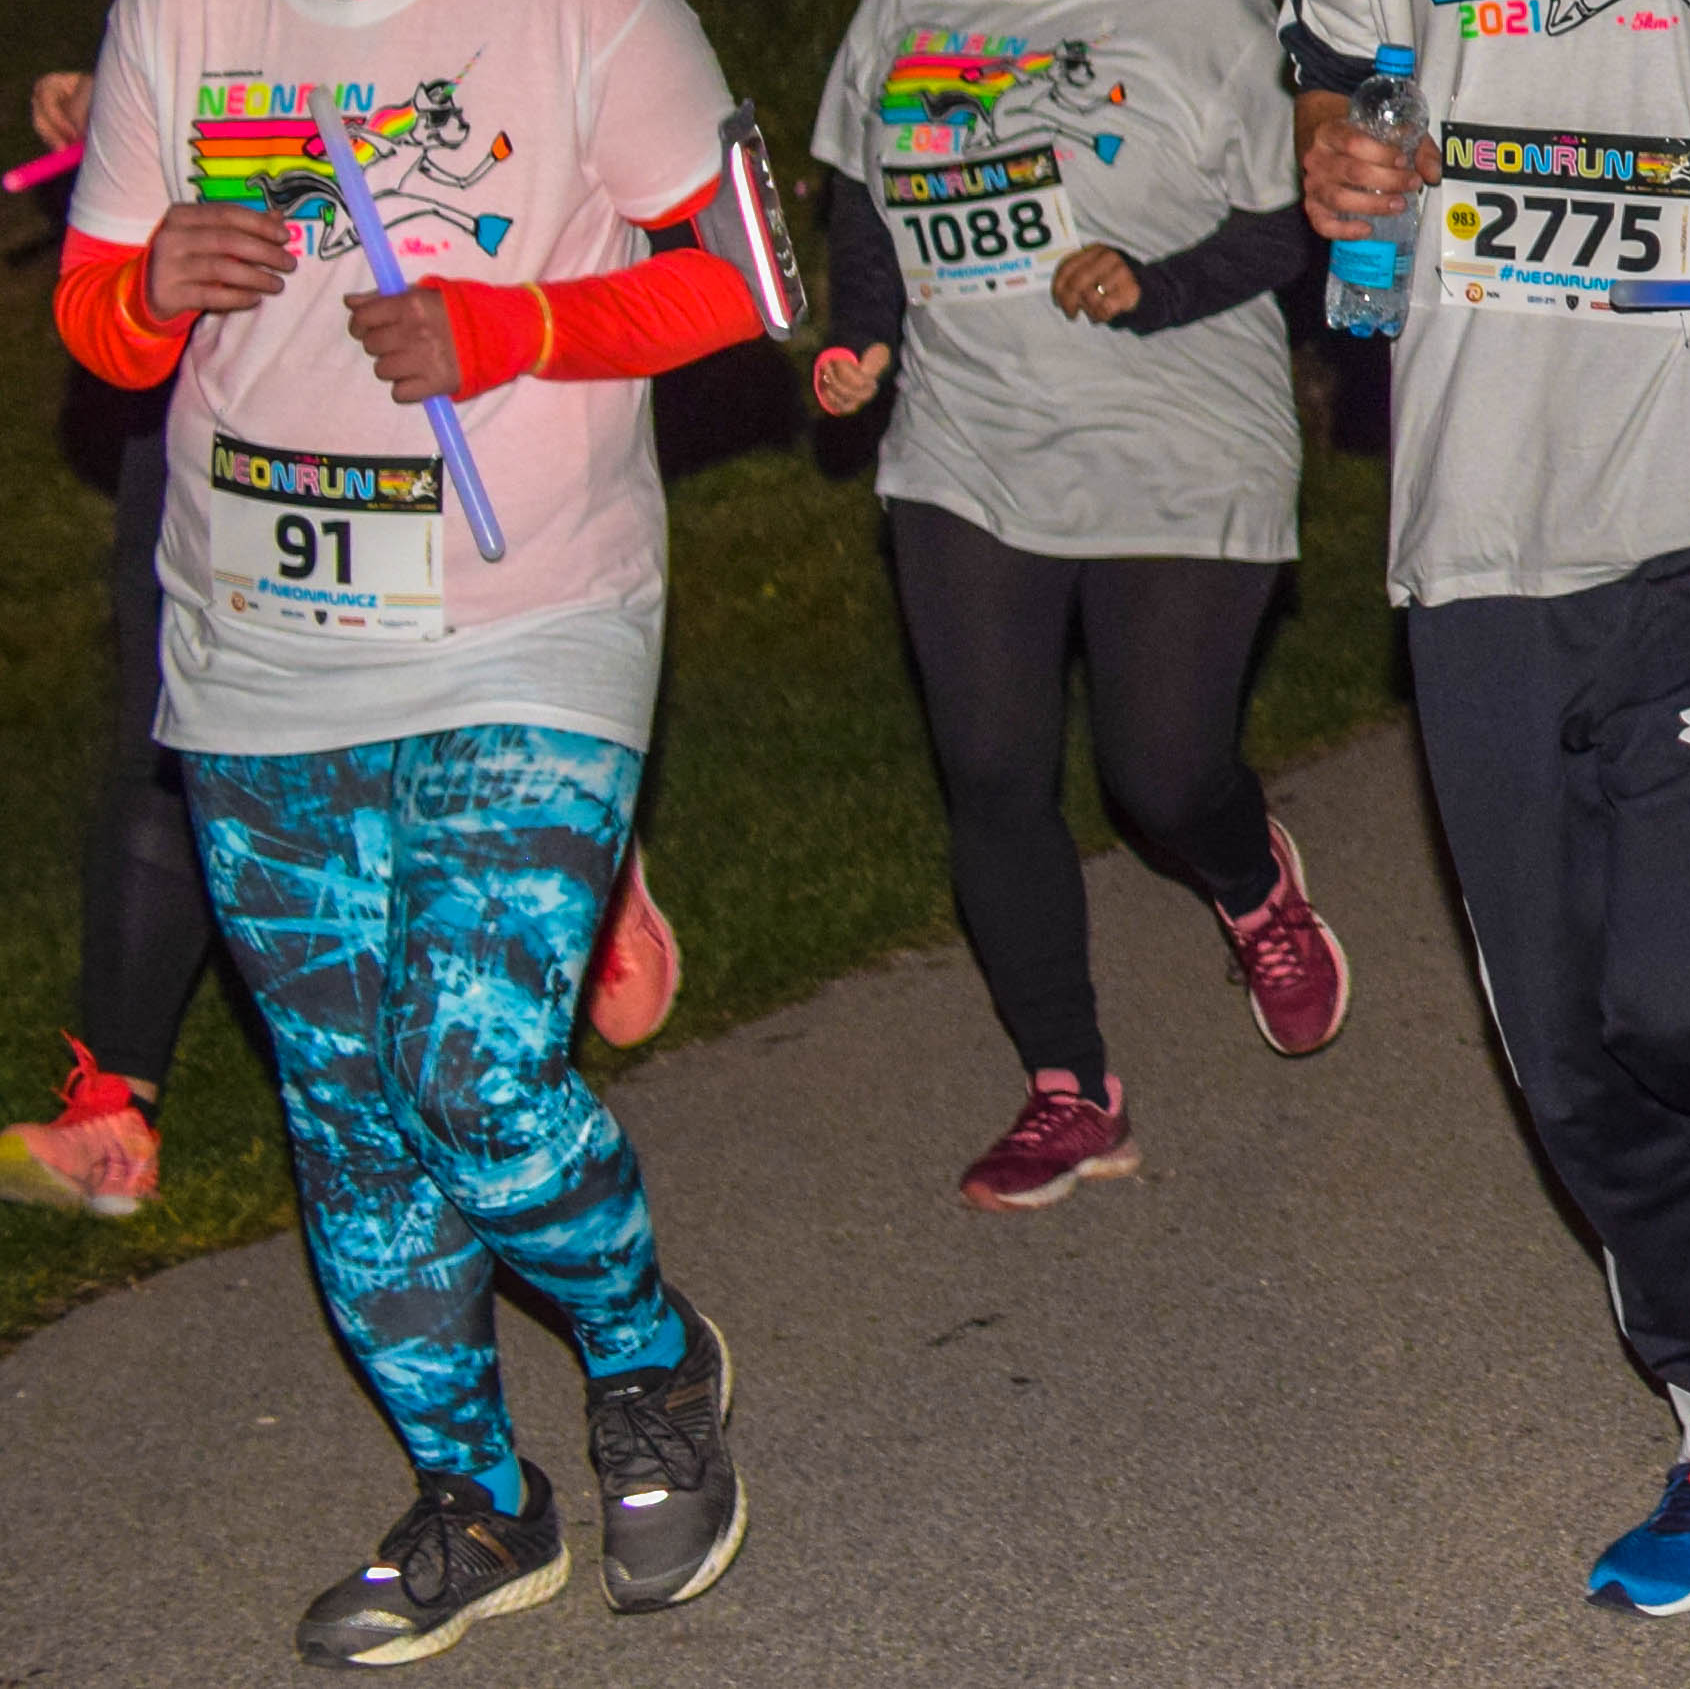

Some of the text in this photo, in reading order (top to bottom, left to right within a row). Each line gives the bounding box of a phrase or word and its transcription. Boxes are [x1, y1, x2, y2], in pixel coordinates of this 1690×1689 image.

[1458, 0, 1542, 39] 2021
[896, 125, 962, 154] 2021
[1446, 136, 1634, 181] NEONRUN
[903, 198, 1052, 265] 1088
[1452, 211, 1476, 226] 983
[1474, 191, 1663, 273] 2775
[215, 446, 375, 500] NEONRUN
[275, 514, 352, 585] 91
